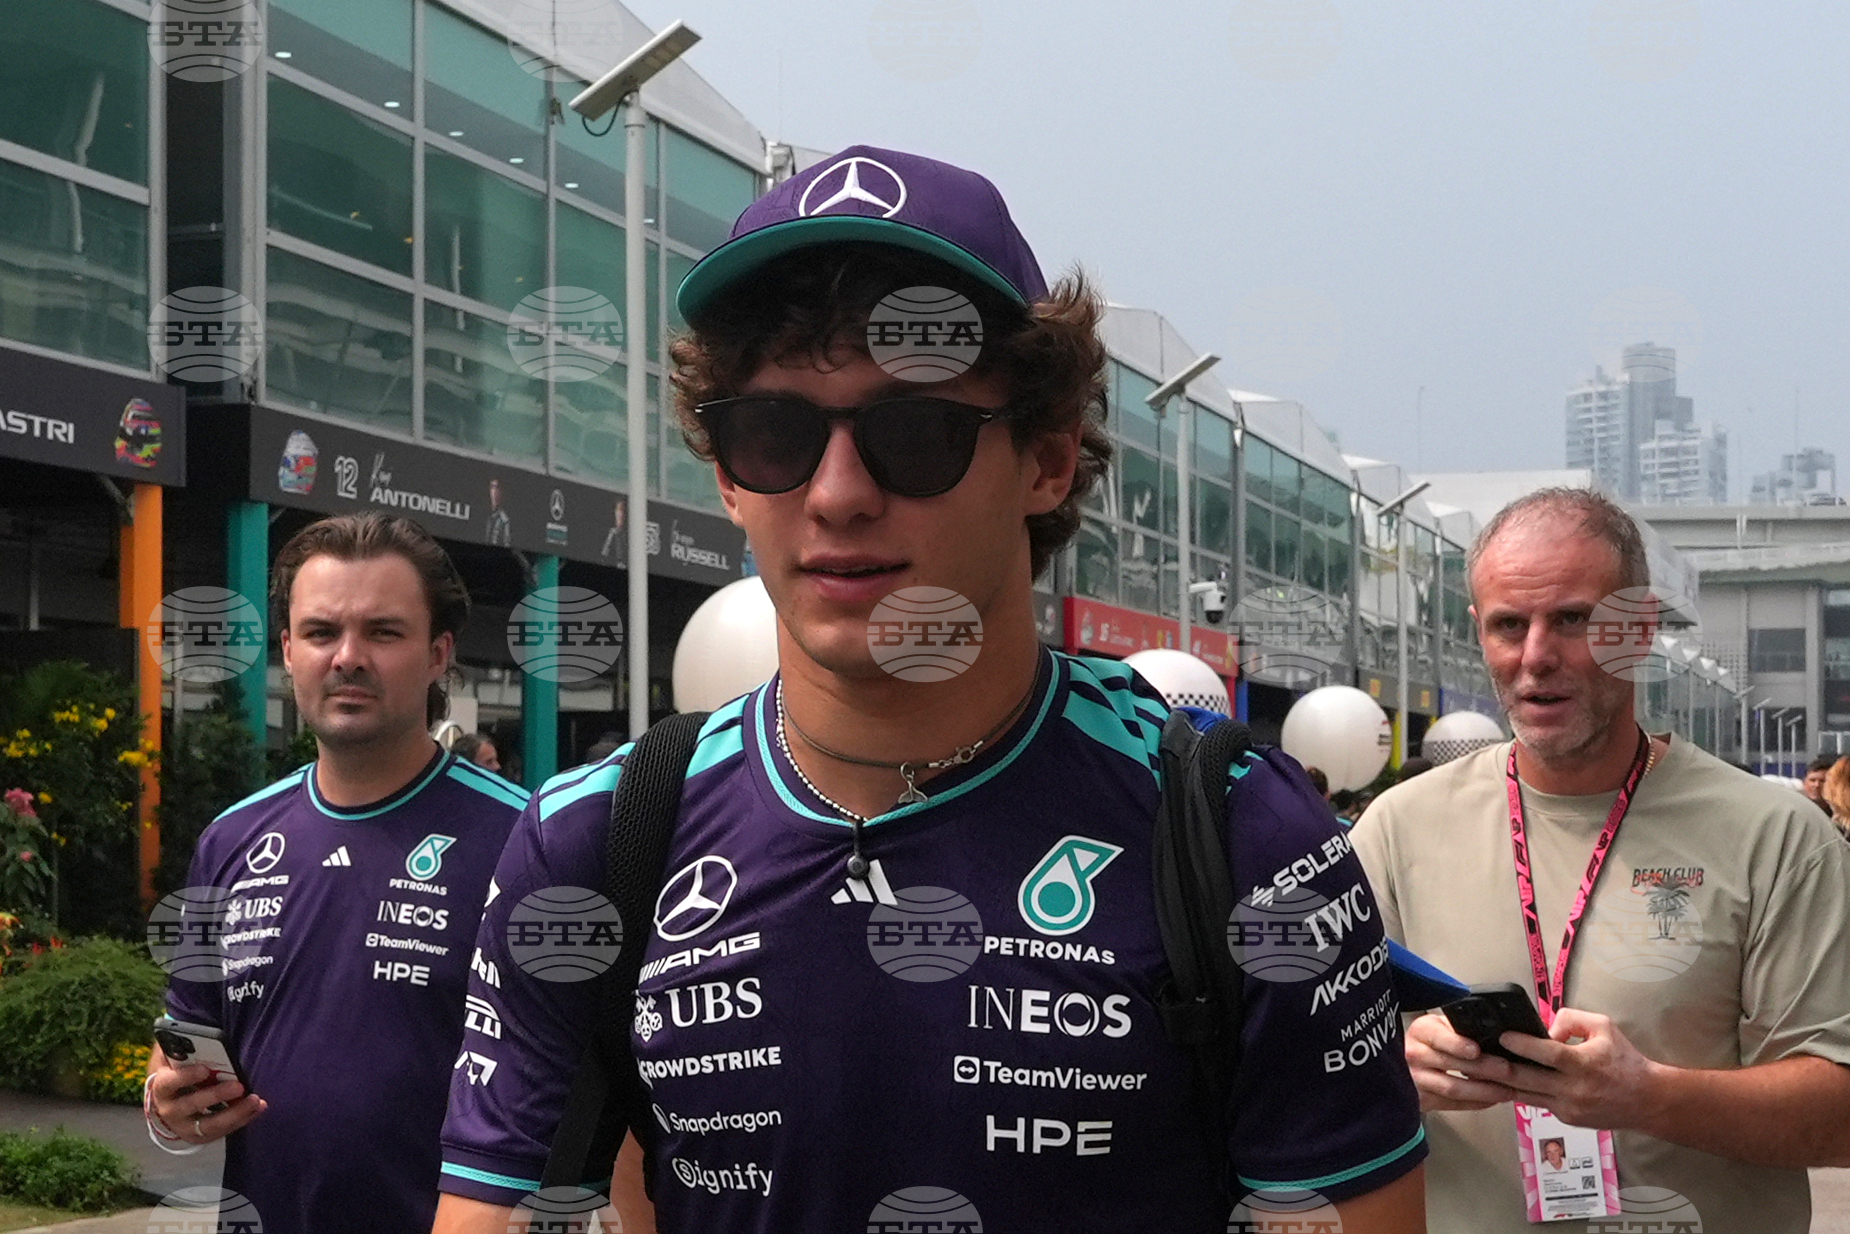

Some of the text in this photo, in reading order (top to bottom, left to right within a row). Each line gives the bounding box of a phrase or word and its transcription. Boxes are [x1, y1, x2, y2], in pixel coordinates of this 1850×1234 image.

[334, 454, 359, 499] 12
[370, 487, 471, 521] ANTONELLI
[671, 543, 730, 571] RUSSELL
[1273, 830, 1351, 897] SOLERA
[248, 875, 289, 888] AMG
[389, 878, 448, 896] PETRONAS
[245, 896, 283, 919] UBS
[377, 900, 449, 930] INEOS
[1304, 882, 1371, 953] IWC
[379, 934, 449, 956] TeamViewer
[660, 932, 761, 974] AMG
[984, 936, 1115, 965] PETRONAS
[373, 960, 430, 986] HPE
[664, 977, 763, 1028] UBS
[967, 985, 1132, 1038] INEOS
[1341, 988, 1391, 1042] MARRIOTT
[1324, 1001, 1399, 1073] BONVOY
[640, 1046, 782, 1079] CROWDSTRIKE
[983, 1060, 1147, 1090] TeamViewer
[669, 1110, 782, 1136] Snapdragon
[986, 1115, 1113, 1156] HPE
